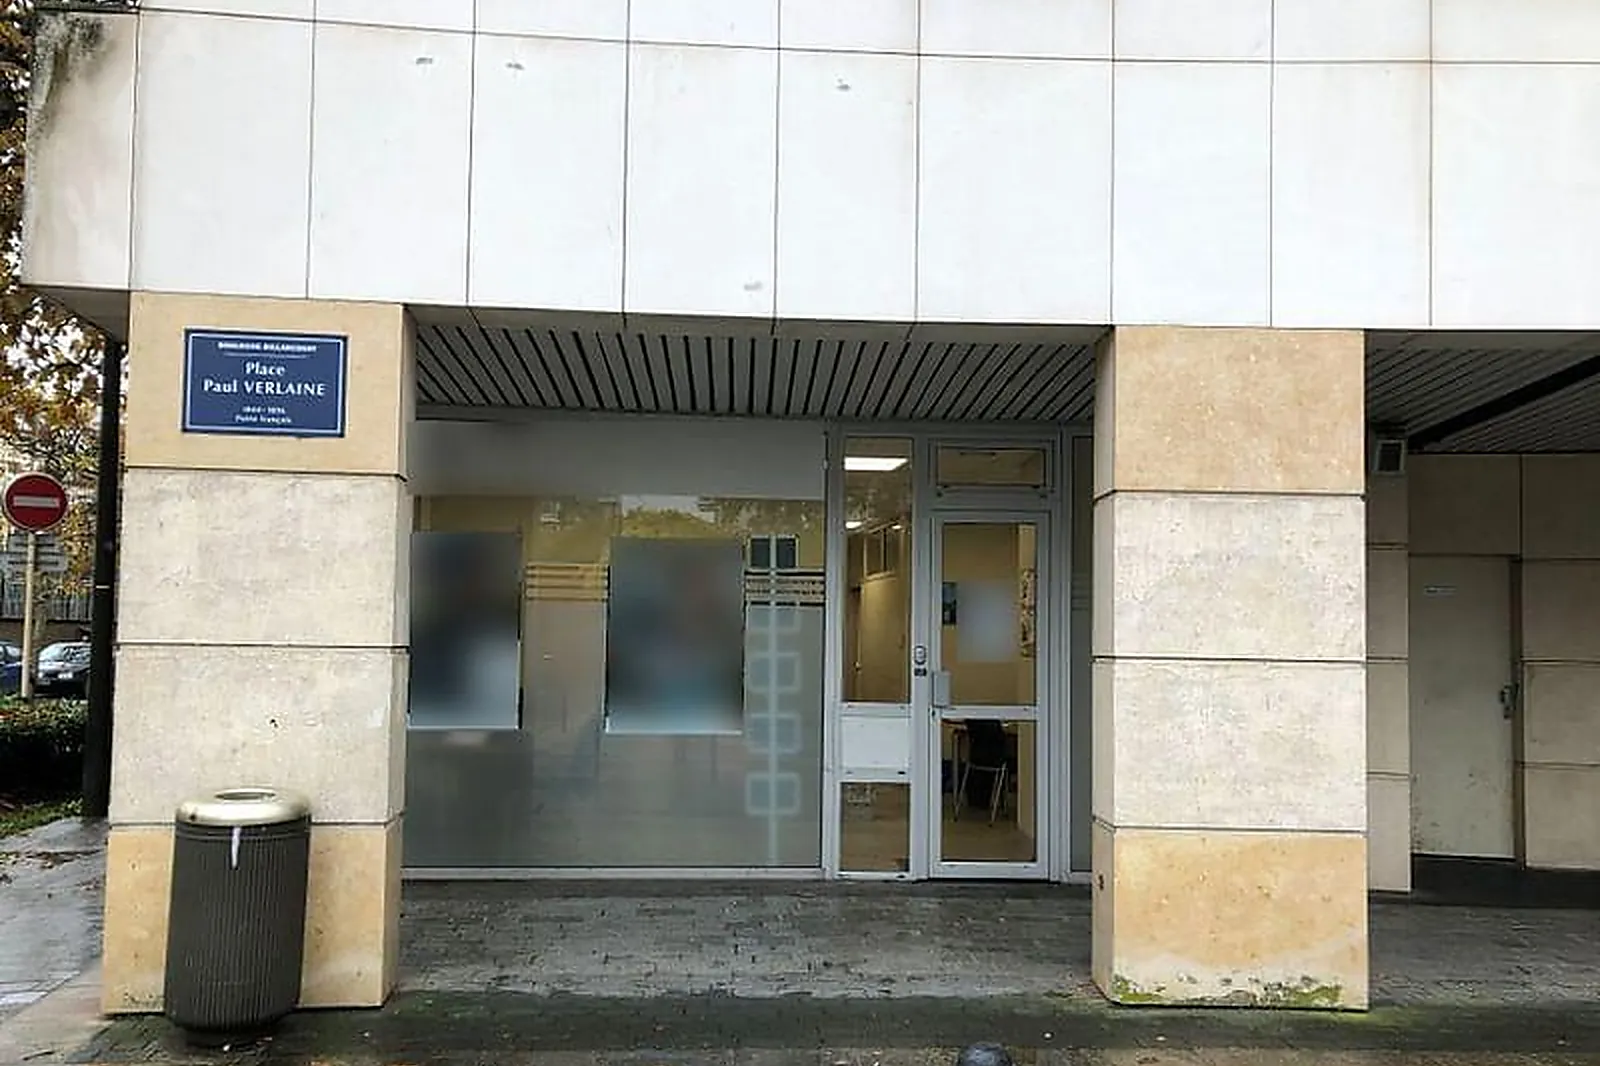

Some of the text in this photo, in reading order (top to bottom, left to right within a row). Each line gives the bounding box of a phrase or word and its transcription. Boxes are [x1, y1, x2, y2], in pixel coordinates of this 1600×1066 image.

[245, 361, 285, 376] Place
[203, 379, 326, 396] Paul VERLAINE
